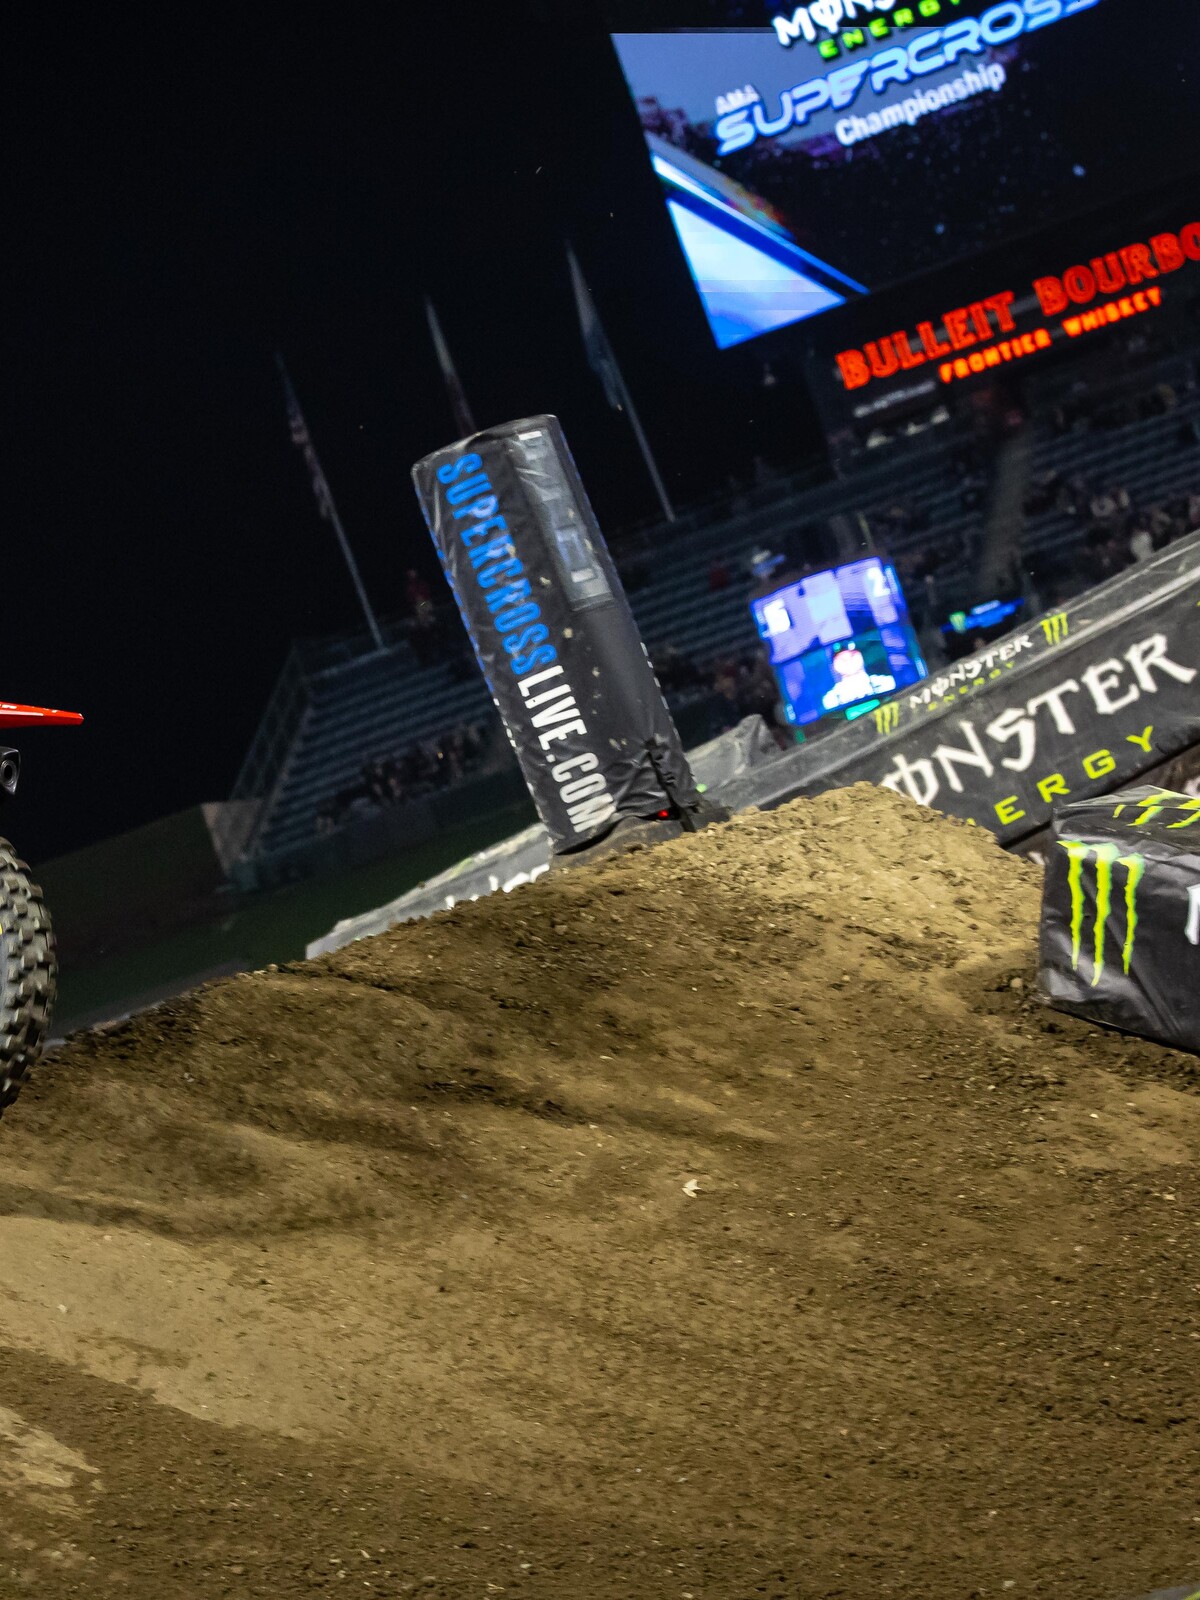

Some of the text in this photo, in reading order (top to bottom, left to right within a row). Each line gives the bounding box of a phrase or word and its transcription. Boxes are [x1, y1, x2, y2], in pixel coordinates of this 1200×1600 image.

[818, 0, 960, 59] ENERG
[834, 60, 1008, 147] Championship
[834, 289, 1017, 391] BULLEIT
[938, 285, 1162, 384] FRONTIER WHISKEY
[436, 452, 618, 834] SUPERCROSSLIVE.COM
[909, 634, 1034, 709] MONSTER
[880, 632, 1198, 806] ONSTER
[966, 725, 1157, 827] ERGY
